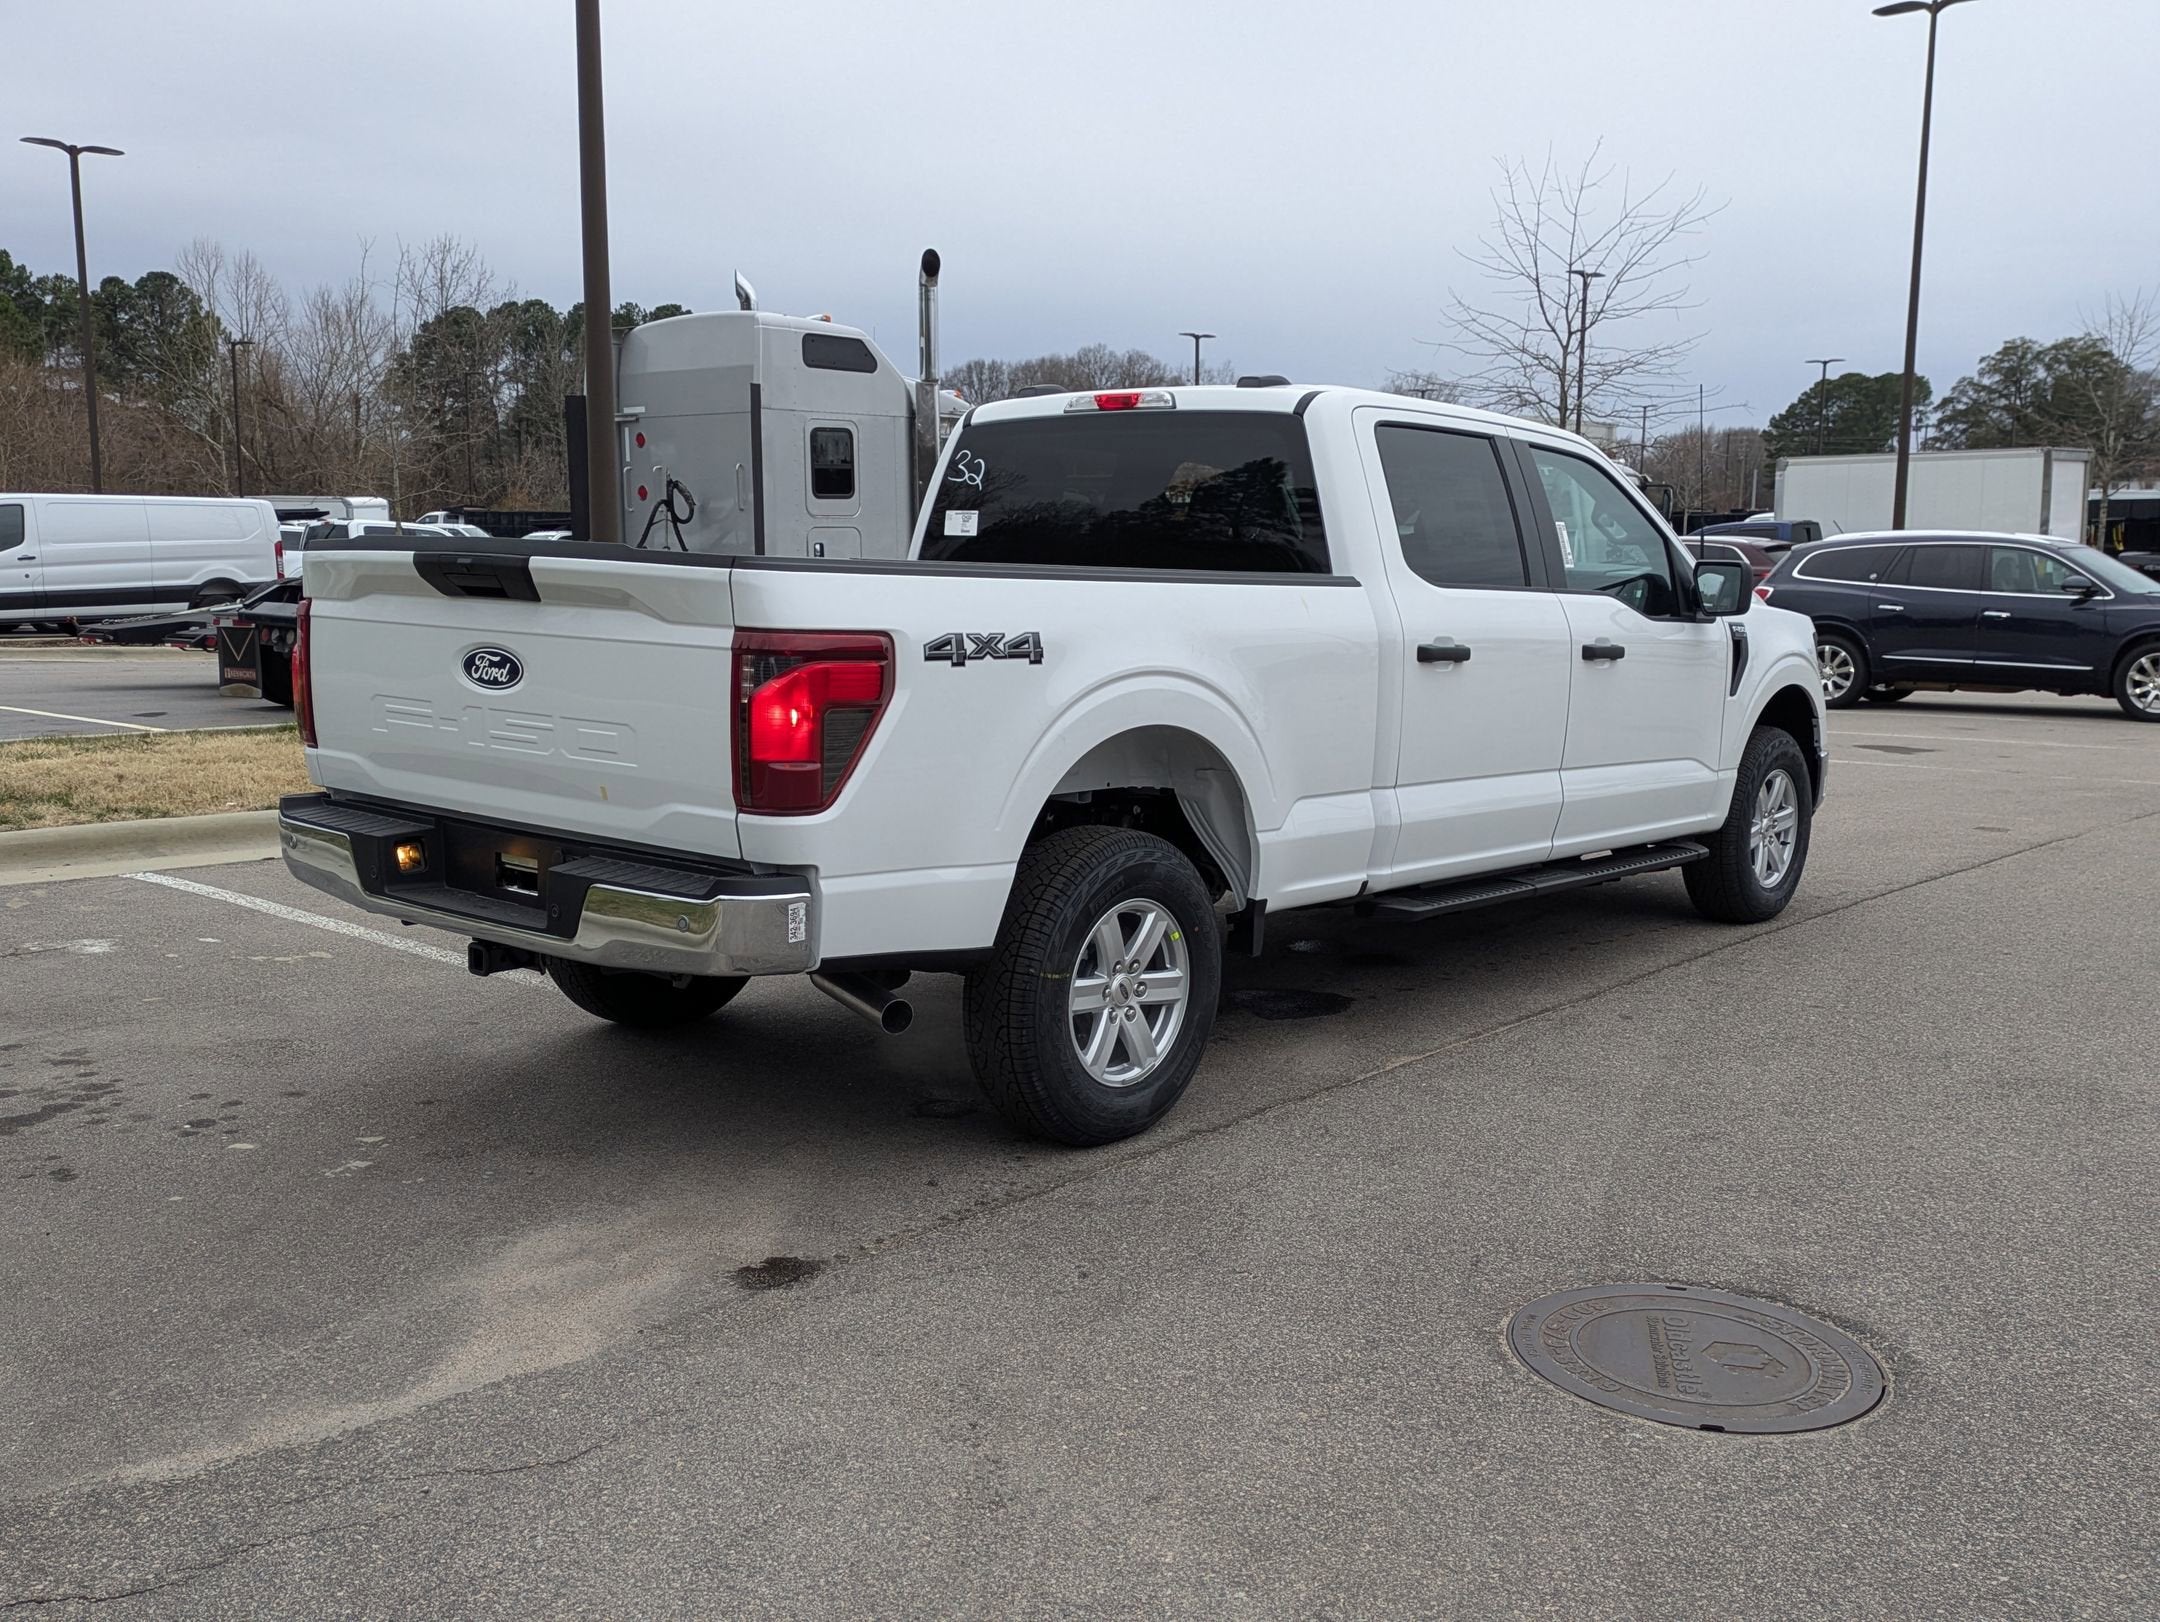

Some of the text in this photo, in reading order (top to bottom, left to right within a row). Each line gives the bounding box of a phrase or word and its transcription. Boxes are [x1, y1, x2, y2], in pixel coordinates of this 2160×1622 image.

[948, 449, 985, 491] 32
[471, 652, 511, 684] Ford
[371, 693, 639, 768] F-150
[1663, 1315, 1703, 1394] Oldcastle
